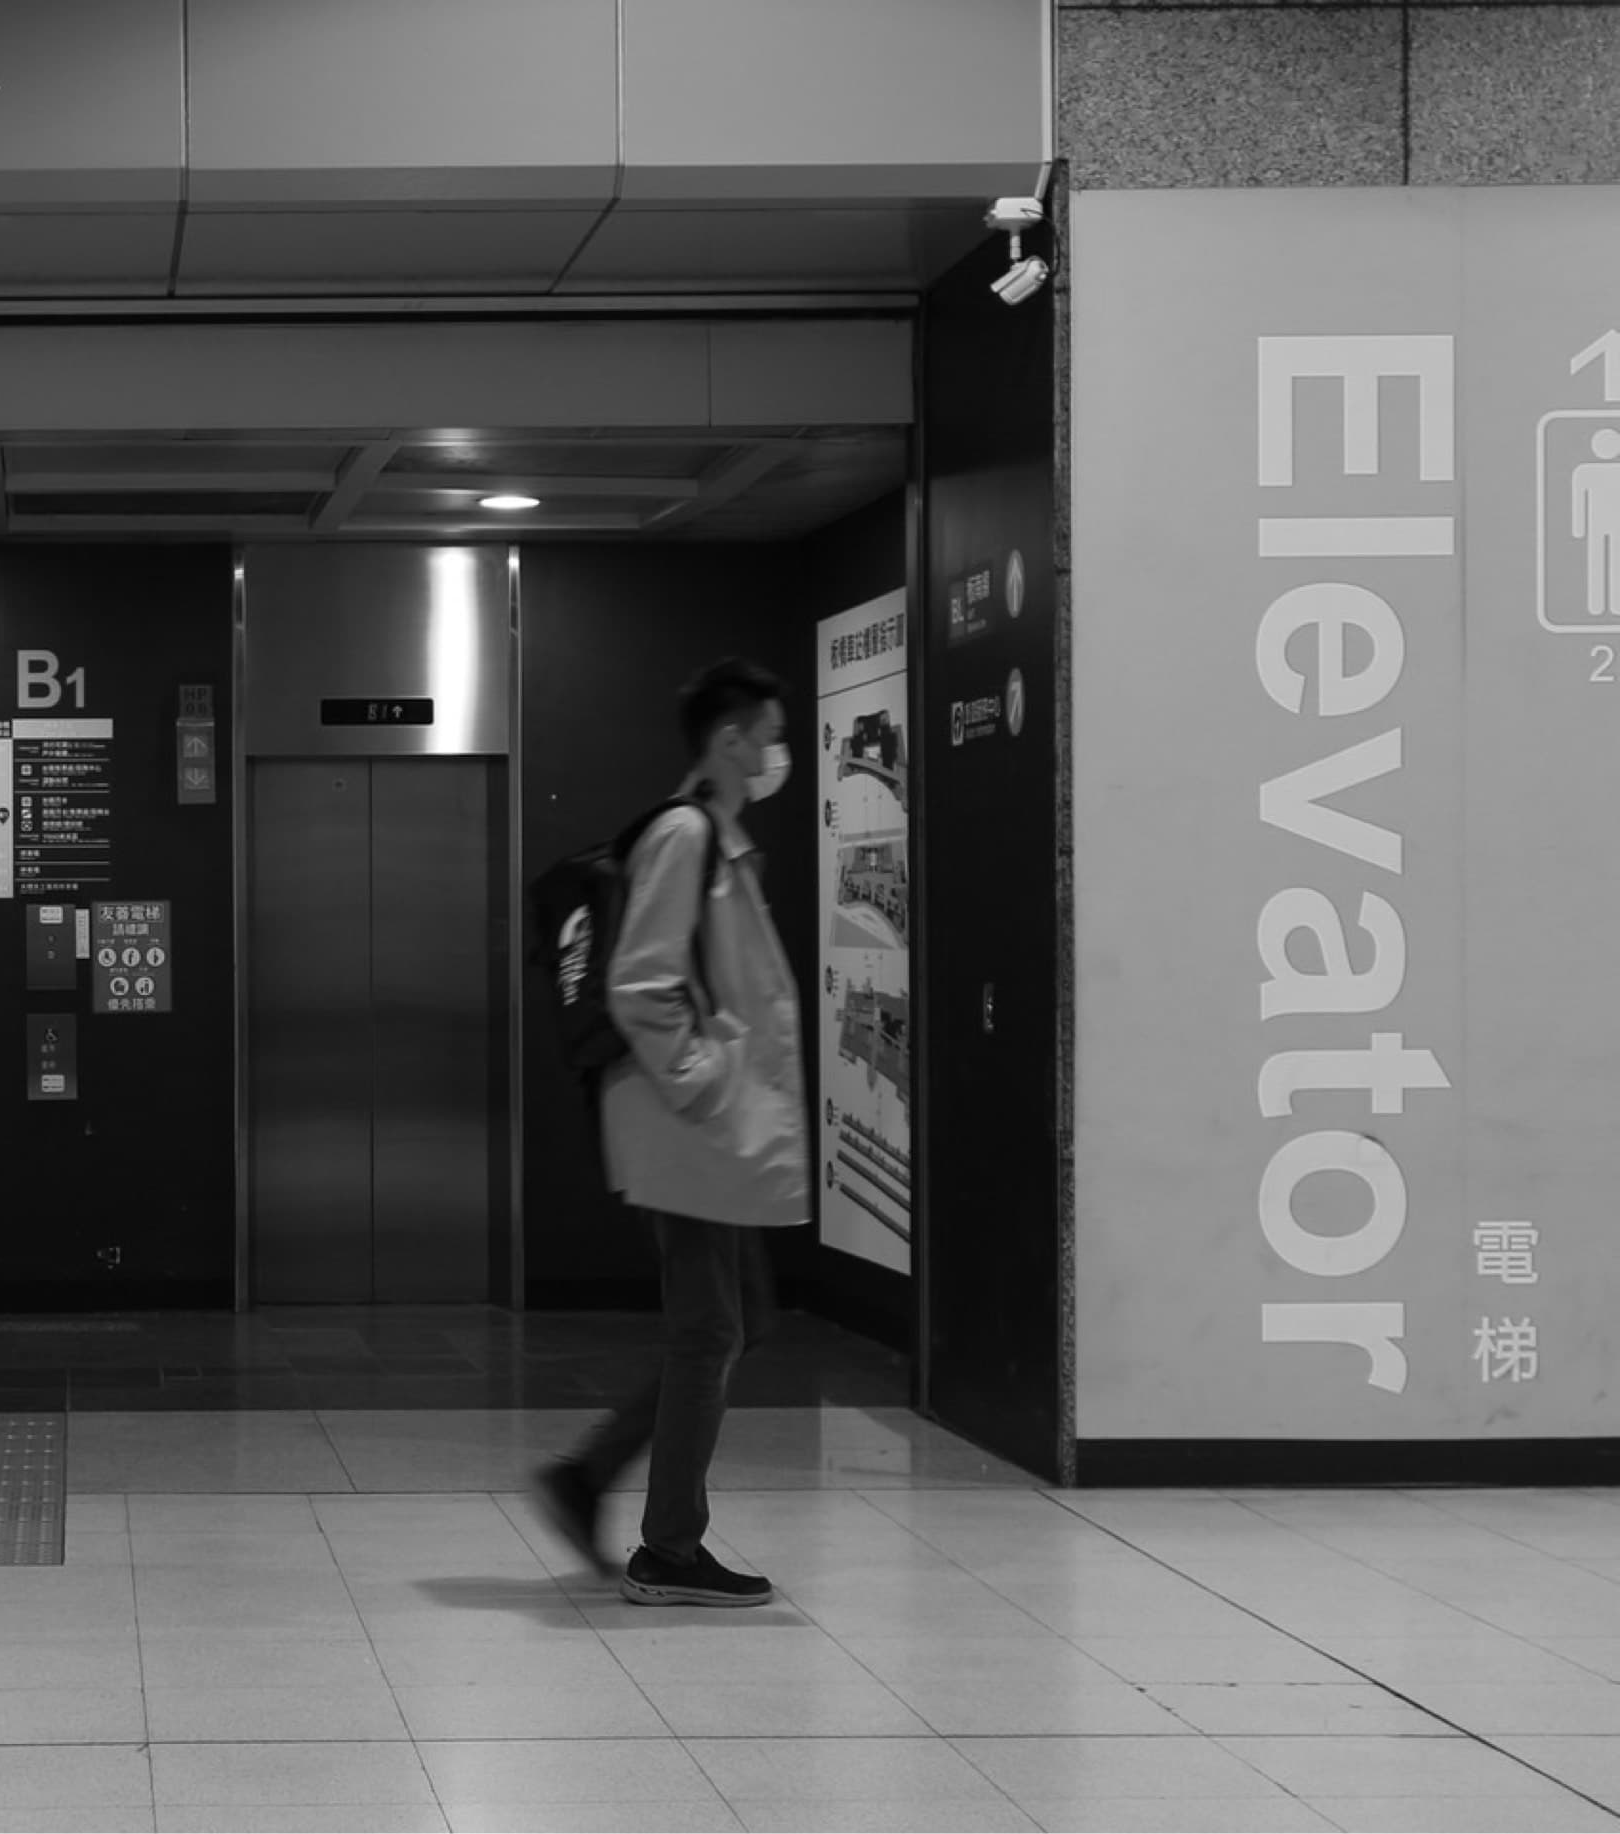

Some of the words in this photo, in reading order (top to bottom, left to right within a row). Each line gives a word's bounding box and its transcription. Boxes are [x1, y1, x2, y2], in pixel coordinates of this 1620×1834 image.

[18, 650, 85, 709] B1
[1587, 643, 1616, 684] 2
[184, 688, 206, 701] HP
[1256, 334, 1455, 1395] Elevator
[100, 905, 161, 921] 友善電梯
[1473, 1220, 1538, 1386] 電梯
